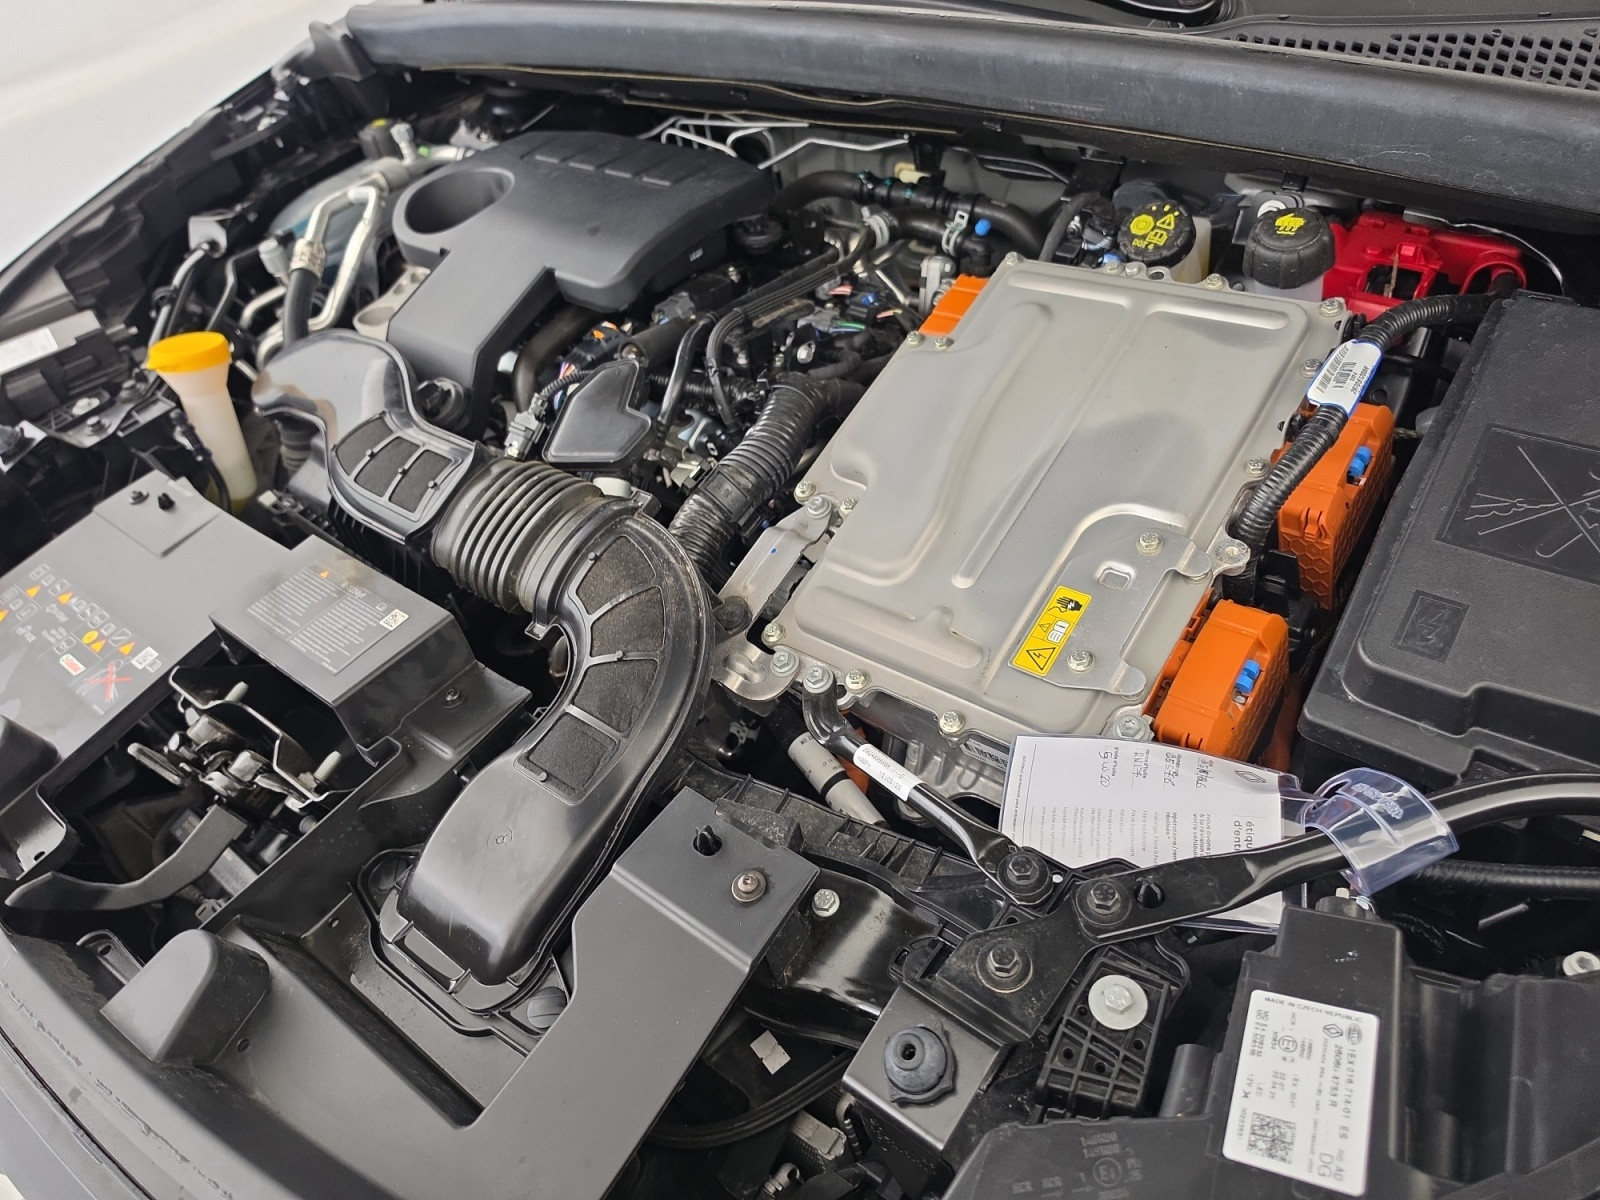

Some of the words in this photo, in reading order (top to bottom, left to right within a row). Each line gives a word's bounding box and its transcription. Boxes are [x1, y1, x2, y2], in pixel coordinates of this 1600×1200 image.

[1131, 238, 1148, 248] DOT
[1244, 821, 1255, 849] étiqu
[1264, 996, 1284, 1005] MADE
[1296, 1004, 1322, 1013] CZECH
[1324, 1010, 1362, 1022] REPUBLIC
